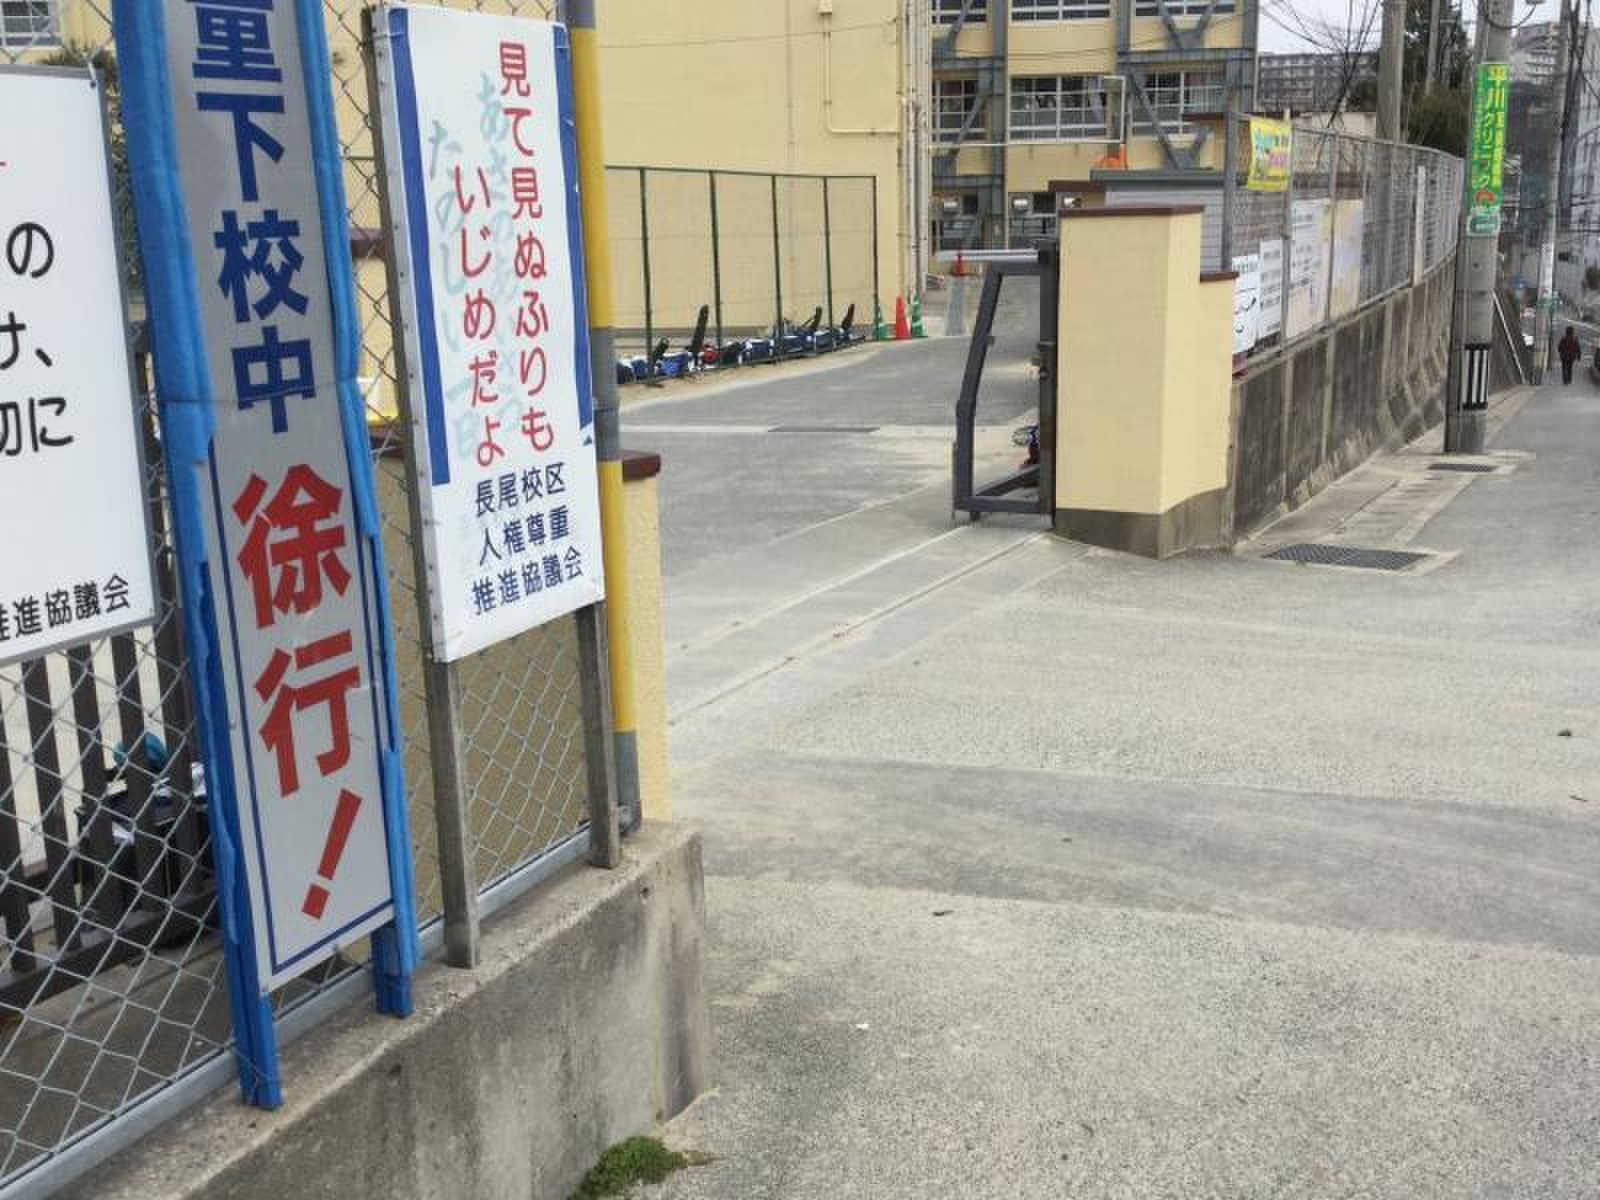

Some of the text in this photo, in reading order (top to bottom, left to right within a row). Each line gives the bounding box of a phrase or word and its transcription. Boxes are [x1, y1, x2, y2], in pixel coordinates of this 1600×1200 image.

[454, 164, 505, 468] いじめだよ
[499, 41, 555, 452] 見て見ぬふりも
[472, 544, 585, 617] 推進協議会
[475, 461, 567, 518] 長尾校区
[479, 504, 570, 567] 人権尊重
[232, 462, 363, 920] 徐行！
